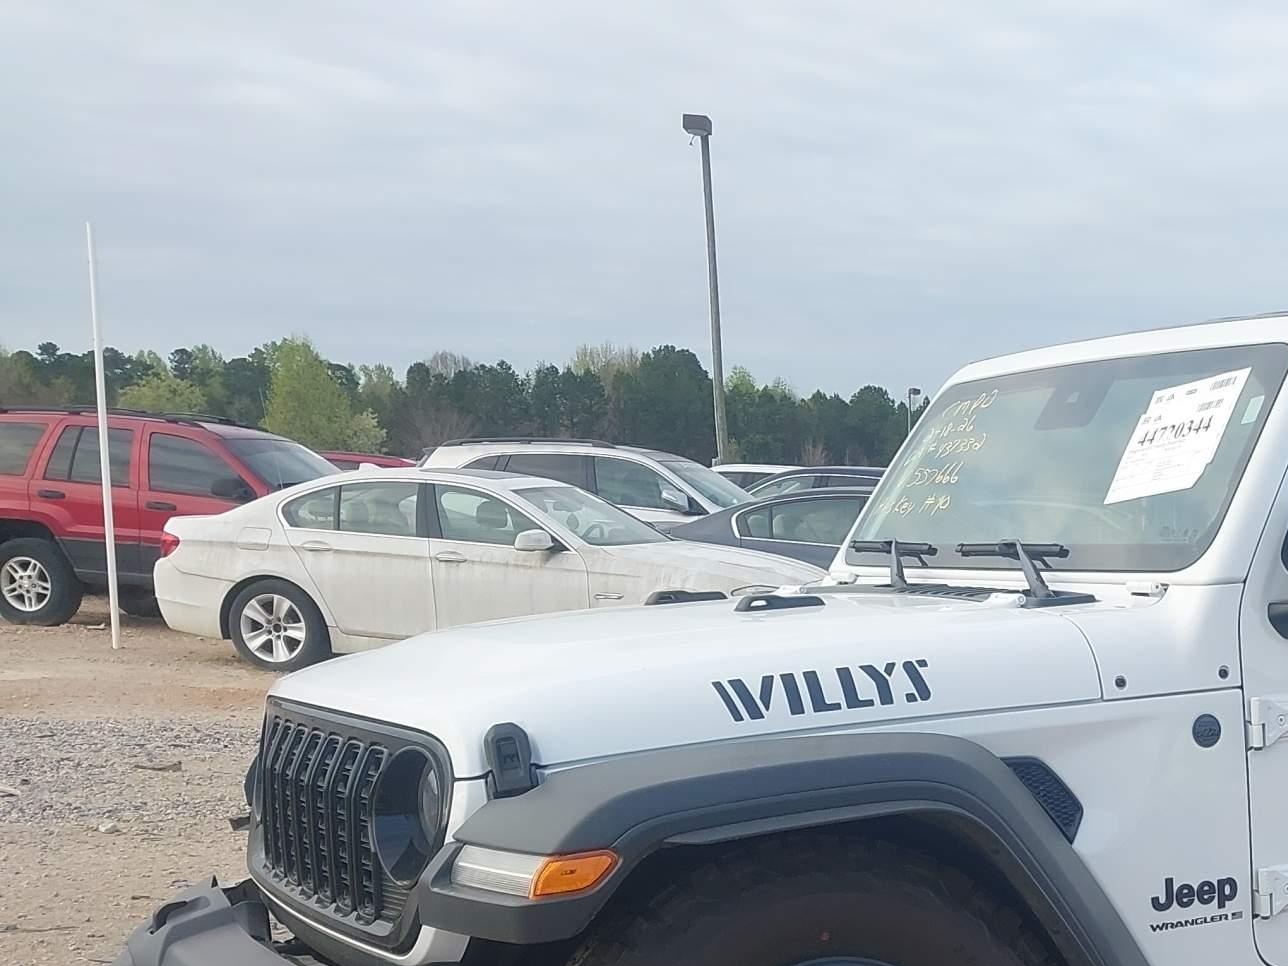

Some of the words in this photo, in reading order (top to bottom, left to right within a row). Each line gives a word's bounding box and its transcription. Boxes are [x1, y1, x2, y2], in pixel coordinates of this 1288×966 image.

[711, 659, 932, 722] WILLYS
[1151, 877, 1238, 912] Jeep
[1150, 913, 1230, 933] WRANGLER
